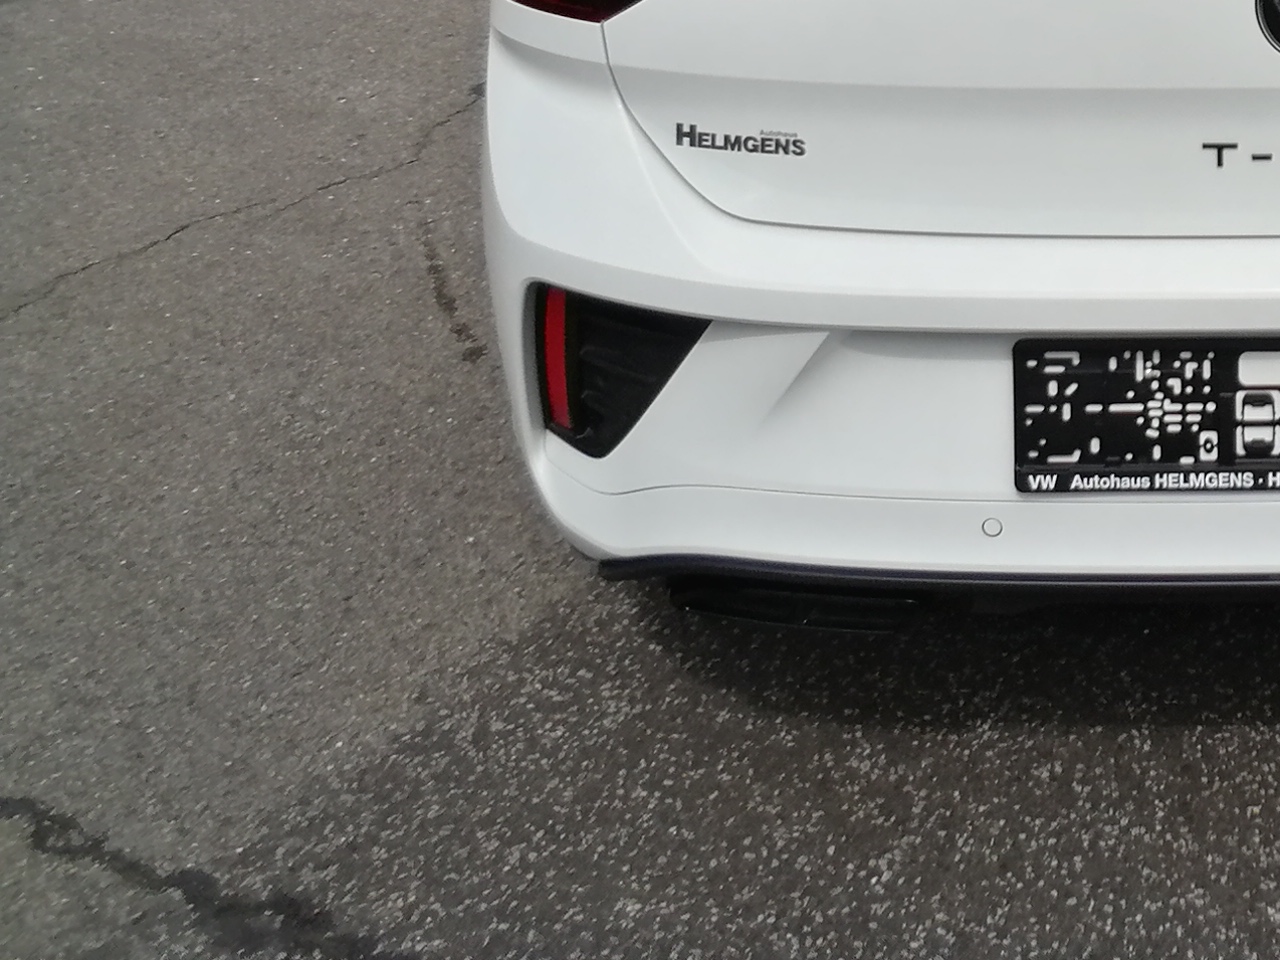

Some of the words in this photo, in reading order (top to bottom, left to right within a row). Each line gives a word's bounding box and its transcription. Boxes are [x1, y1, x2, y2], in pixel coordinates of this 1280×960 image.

[1028, 474, 1057, 489] VW
[1070, 474, 1150, 489] Autohaus
[1154, 472, 1254, 488] HELMGENS
